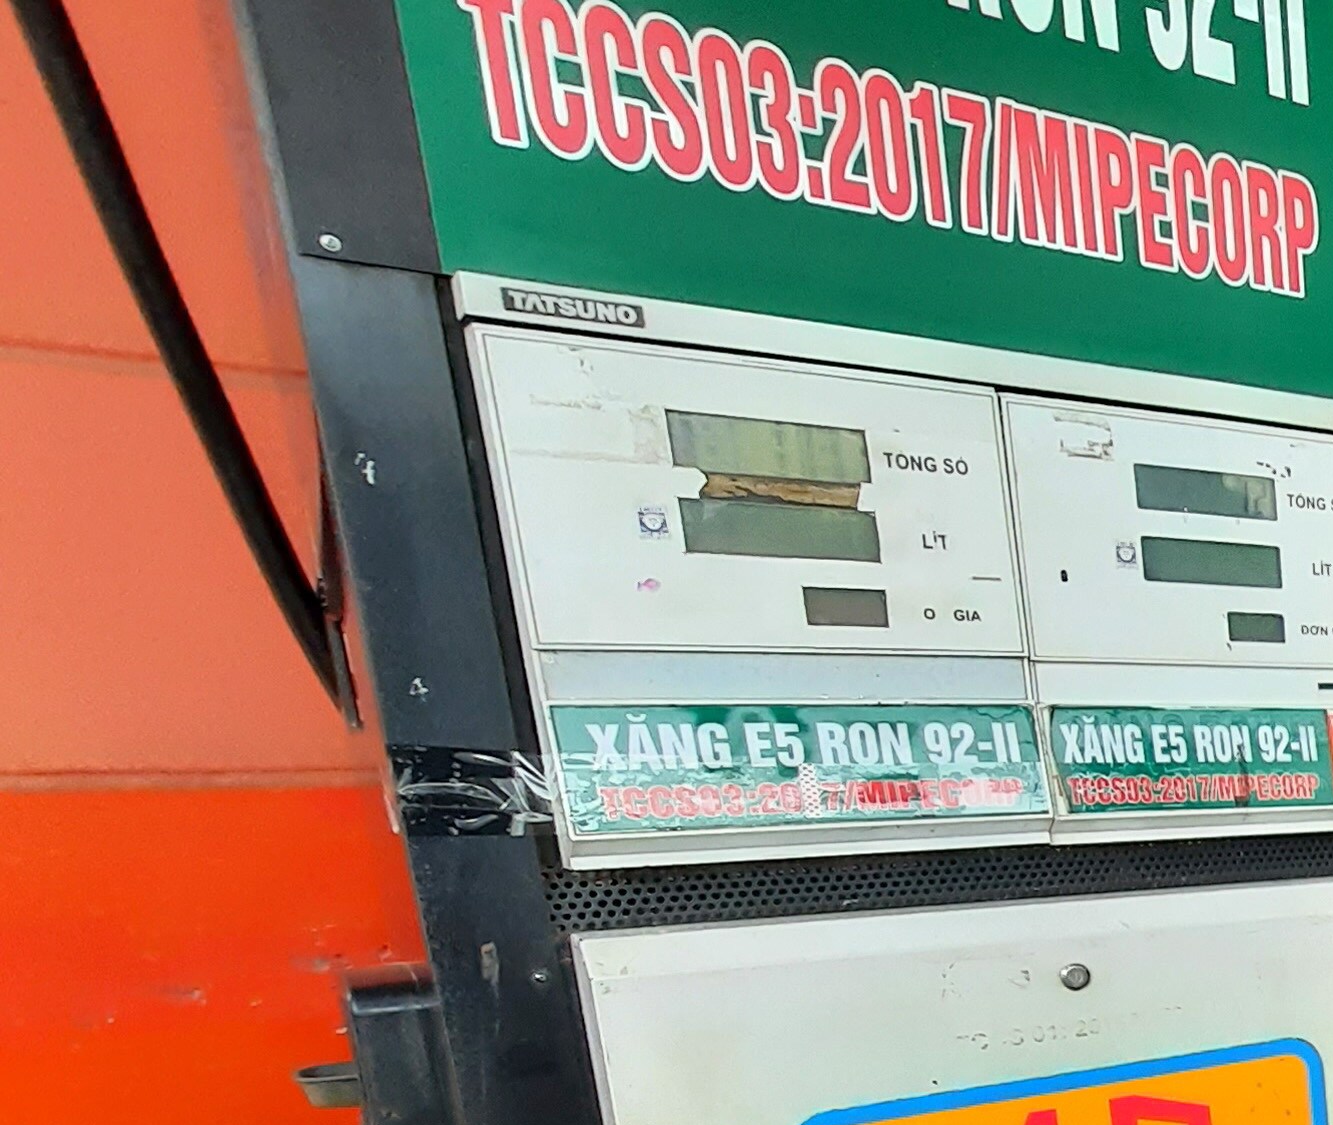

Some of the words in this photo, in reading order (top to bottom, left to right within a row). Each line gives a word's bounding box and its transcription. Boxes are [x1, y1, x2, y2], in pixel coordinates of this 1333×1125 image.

[457, 0, 1318, 299] TCCS03:2017/MIPECORP
[507, 290, 638, 325] TATSUNO
[586, 713, 733, 770] XĂNG
[743, 722, 806, 768] E5
[816, 721, 913, 767] RON
[923, 721, 1023, 765] 92-II
[1060, 716, 1146, 764] XĂNG
[1152, 723, 1188, 763] E5
[1194, 722, 1251, 764] RON
[1257, 724, 1319, 763] 92-II
[599, 777, 1025, 822] TCCS03:207/MIPECORP
